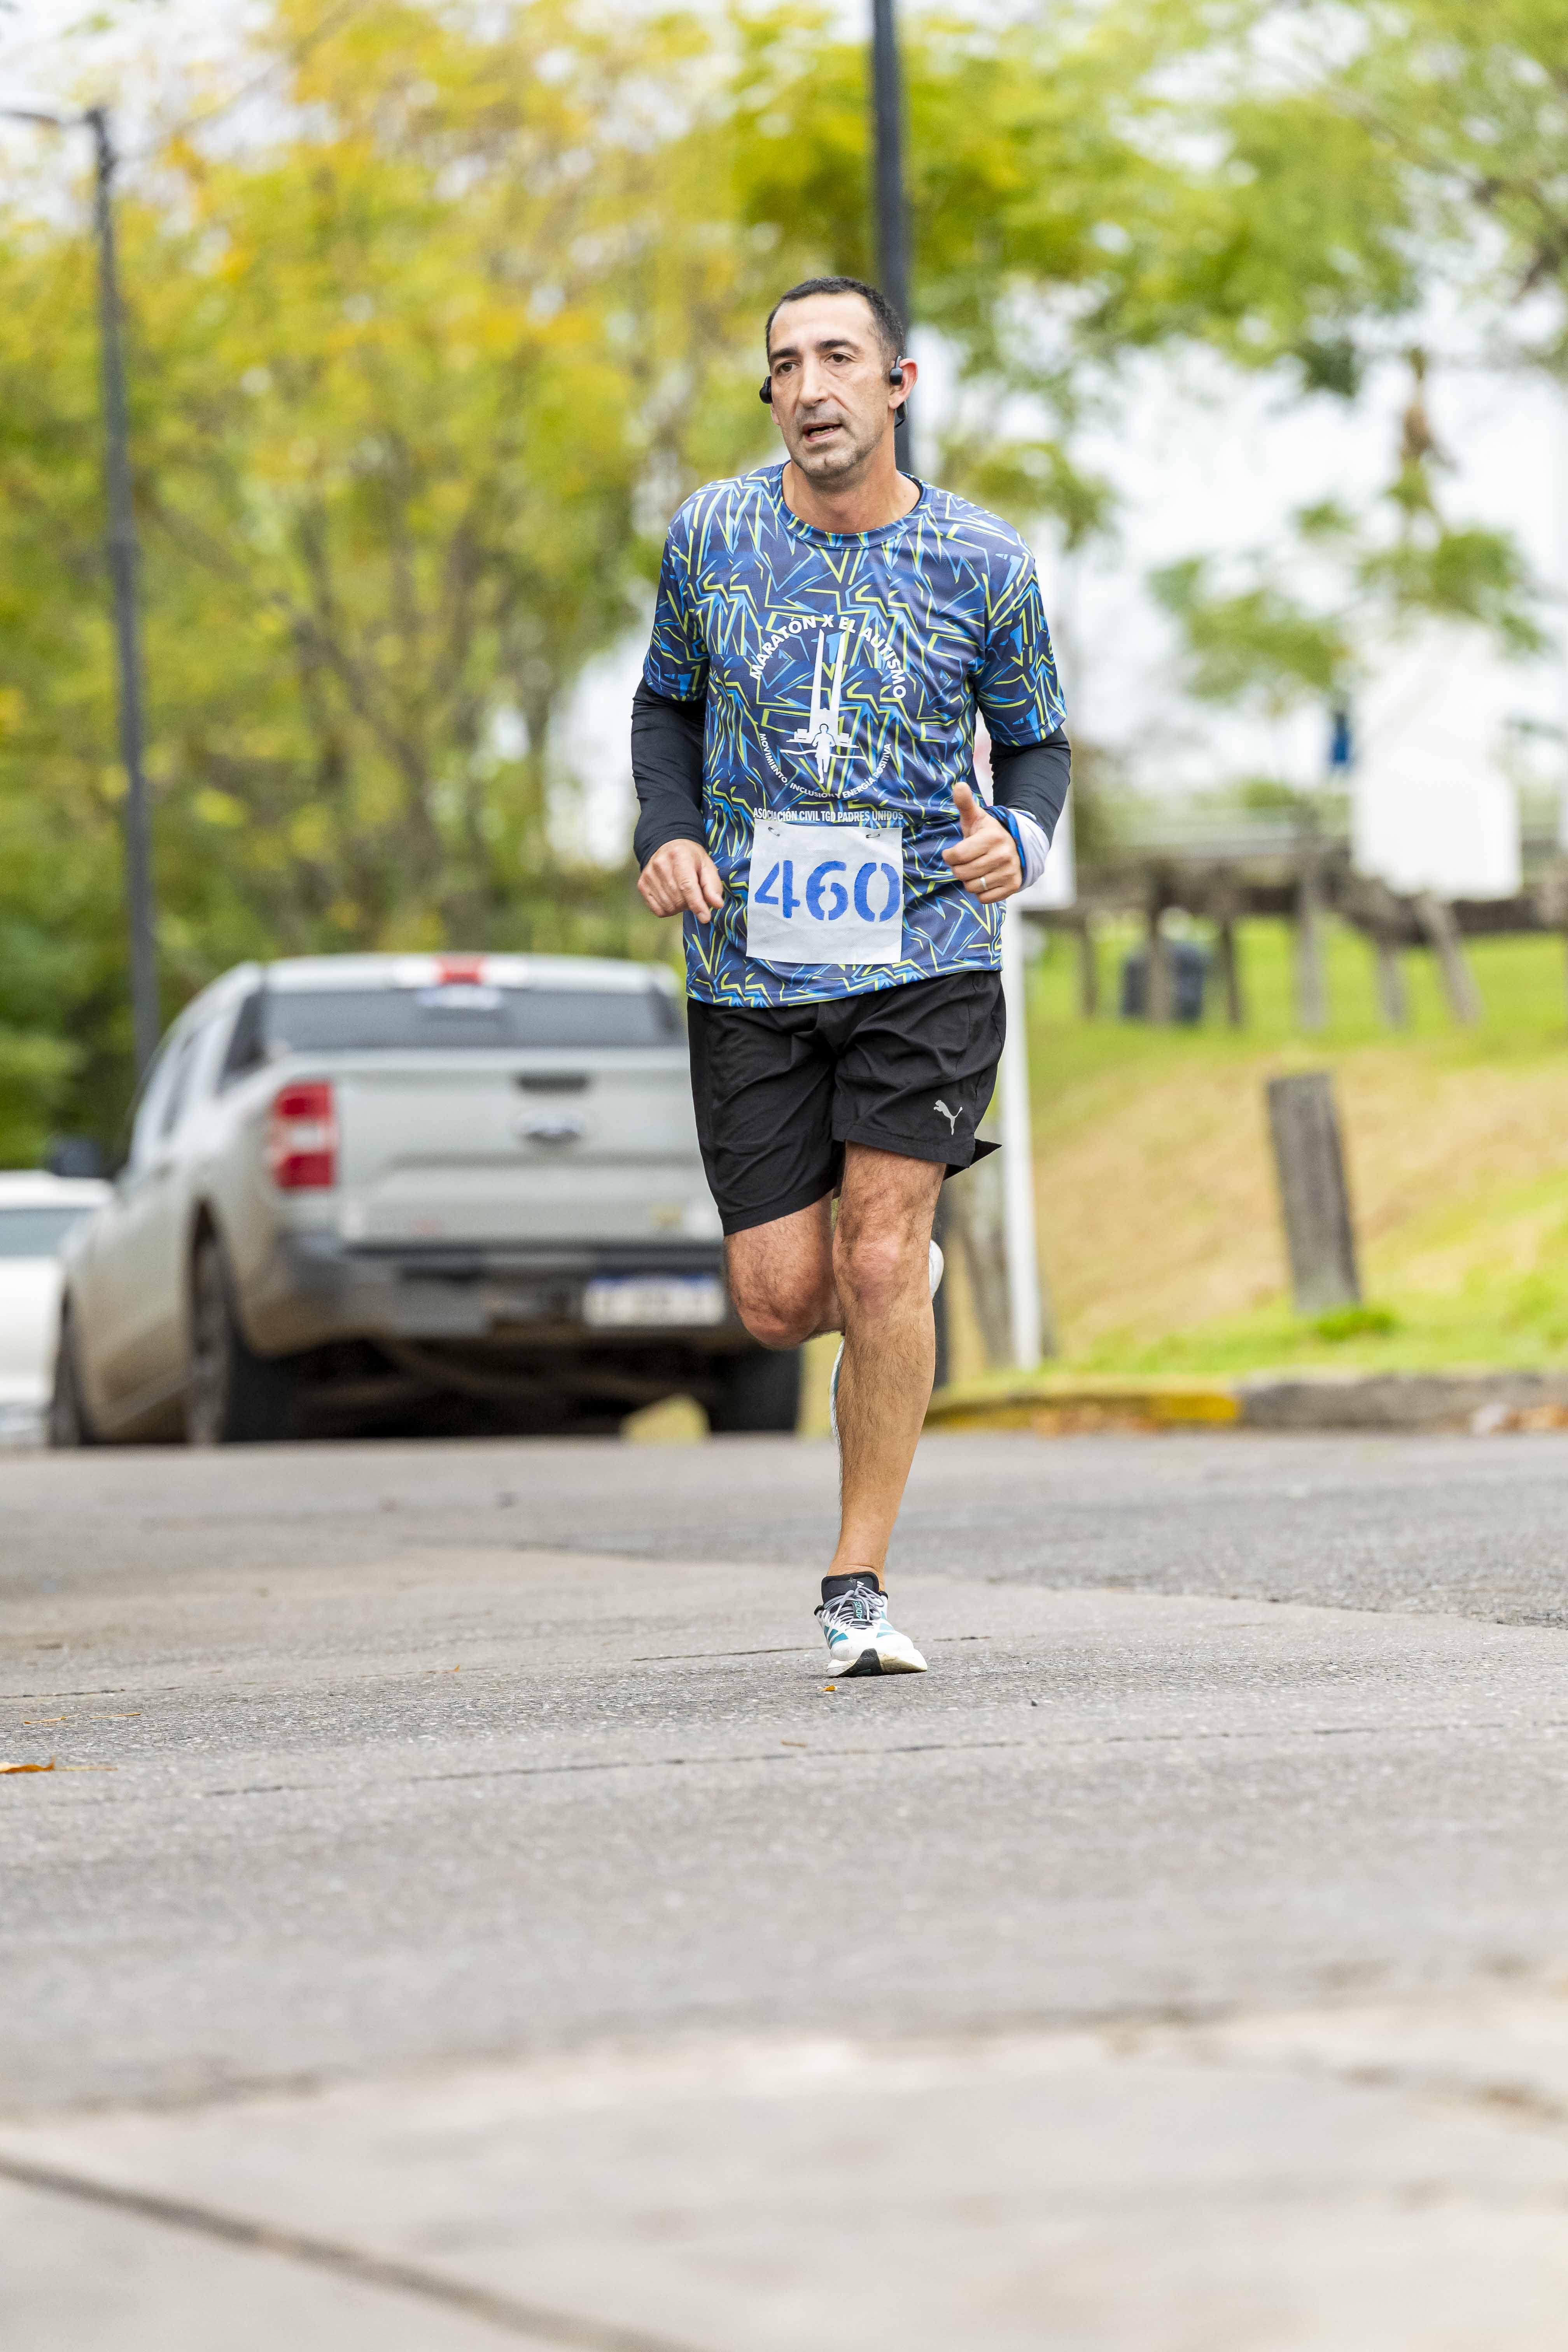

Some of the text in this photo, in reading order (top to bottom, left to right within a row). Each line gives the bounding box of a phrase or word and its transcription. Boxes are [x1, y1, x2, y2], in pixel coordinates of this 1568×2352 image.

[749, 614, 906, 699] MARATÓN X EL AUTISMO
[873, 744, 891, 779] POSITIVA
[753, 807, 904, 822] ASOCIACIÓN CIVIL TGD PADRES UNIDOS
[754, 859, 901, 922] 460
